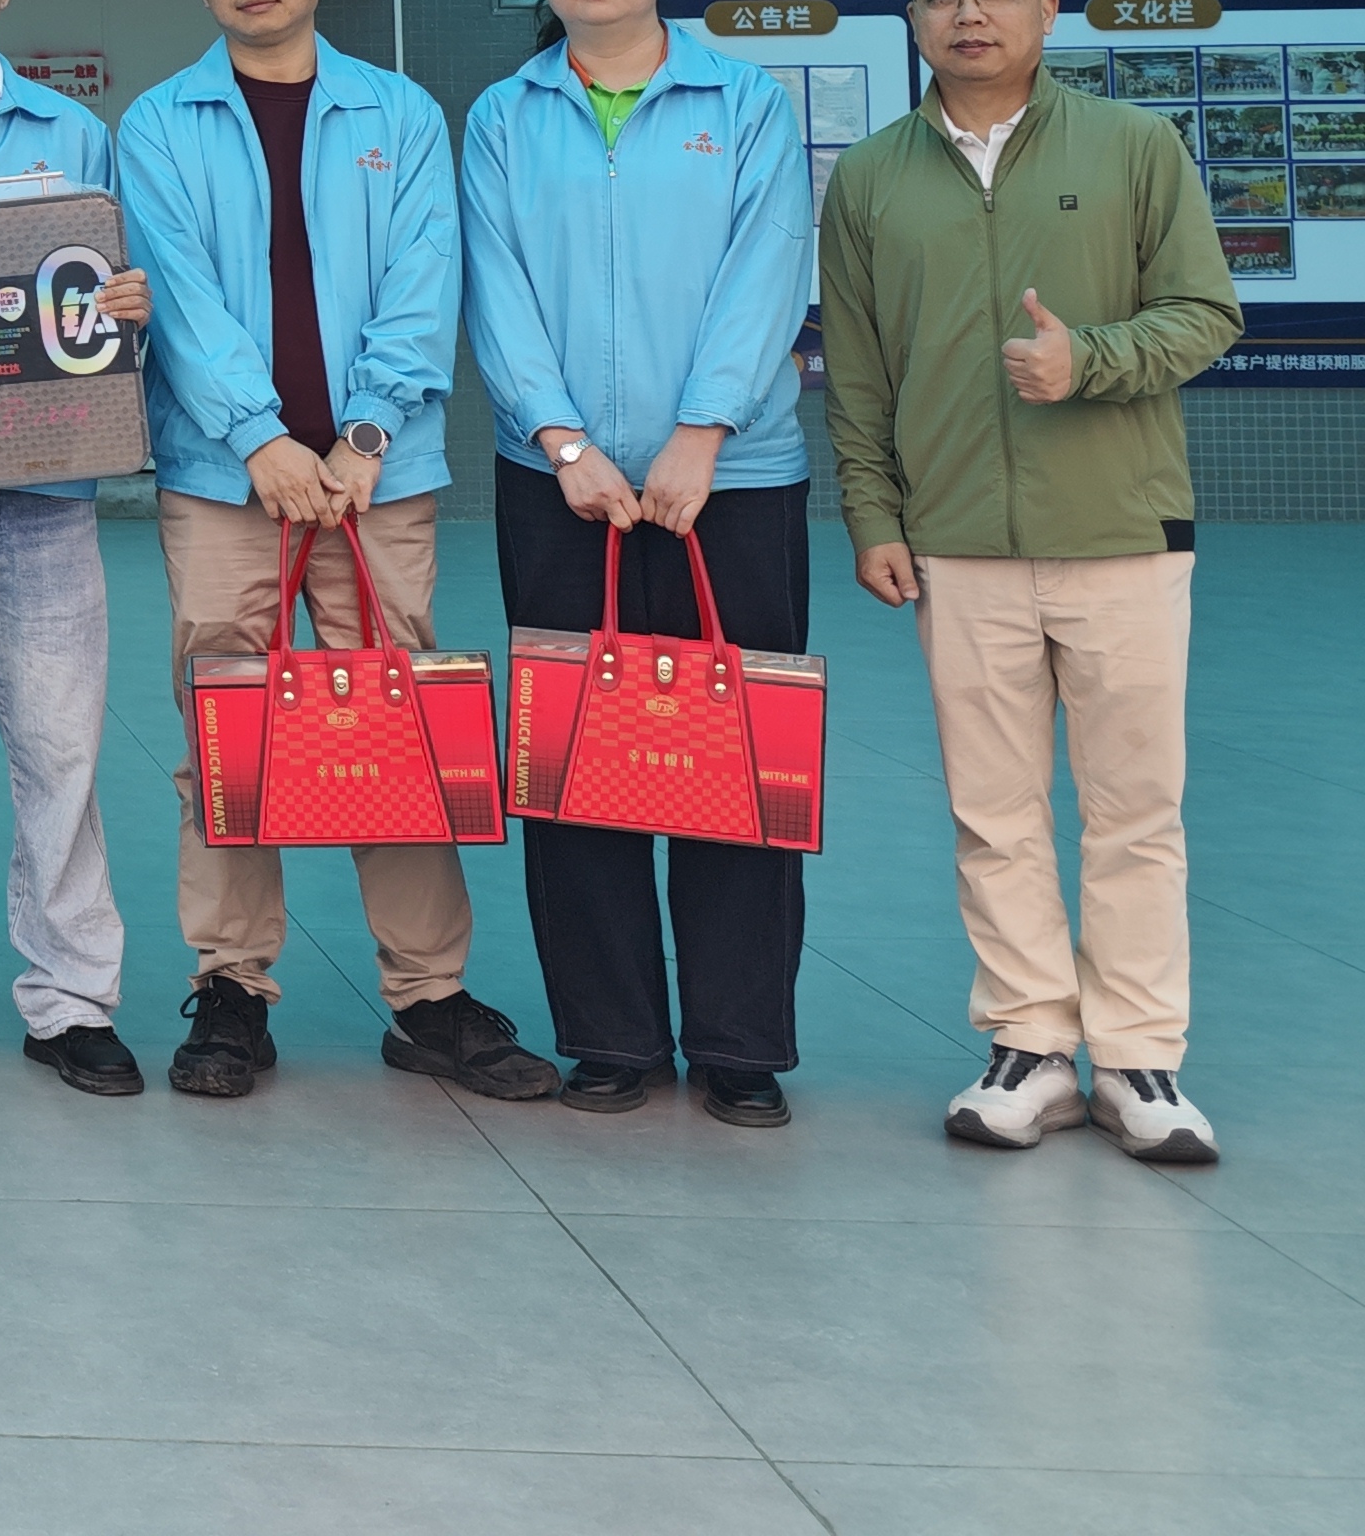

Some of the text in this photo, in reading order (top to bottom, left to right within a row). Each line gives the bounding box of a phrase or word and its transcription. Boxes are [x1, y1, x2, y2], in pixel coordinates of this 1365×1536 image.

[732, 5, 812, 30] 公告栏
[1113, 0, 1195, 25] 文化栏
[515, 667, 534, 806] GOOD LUCK ALWAYS
[203, 697, 227, 836] GOOD LUCK ALWAYS
[440, 768, 486, 779] WITH ME
[759, 770, 809, 784] WITH ME
